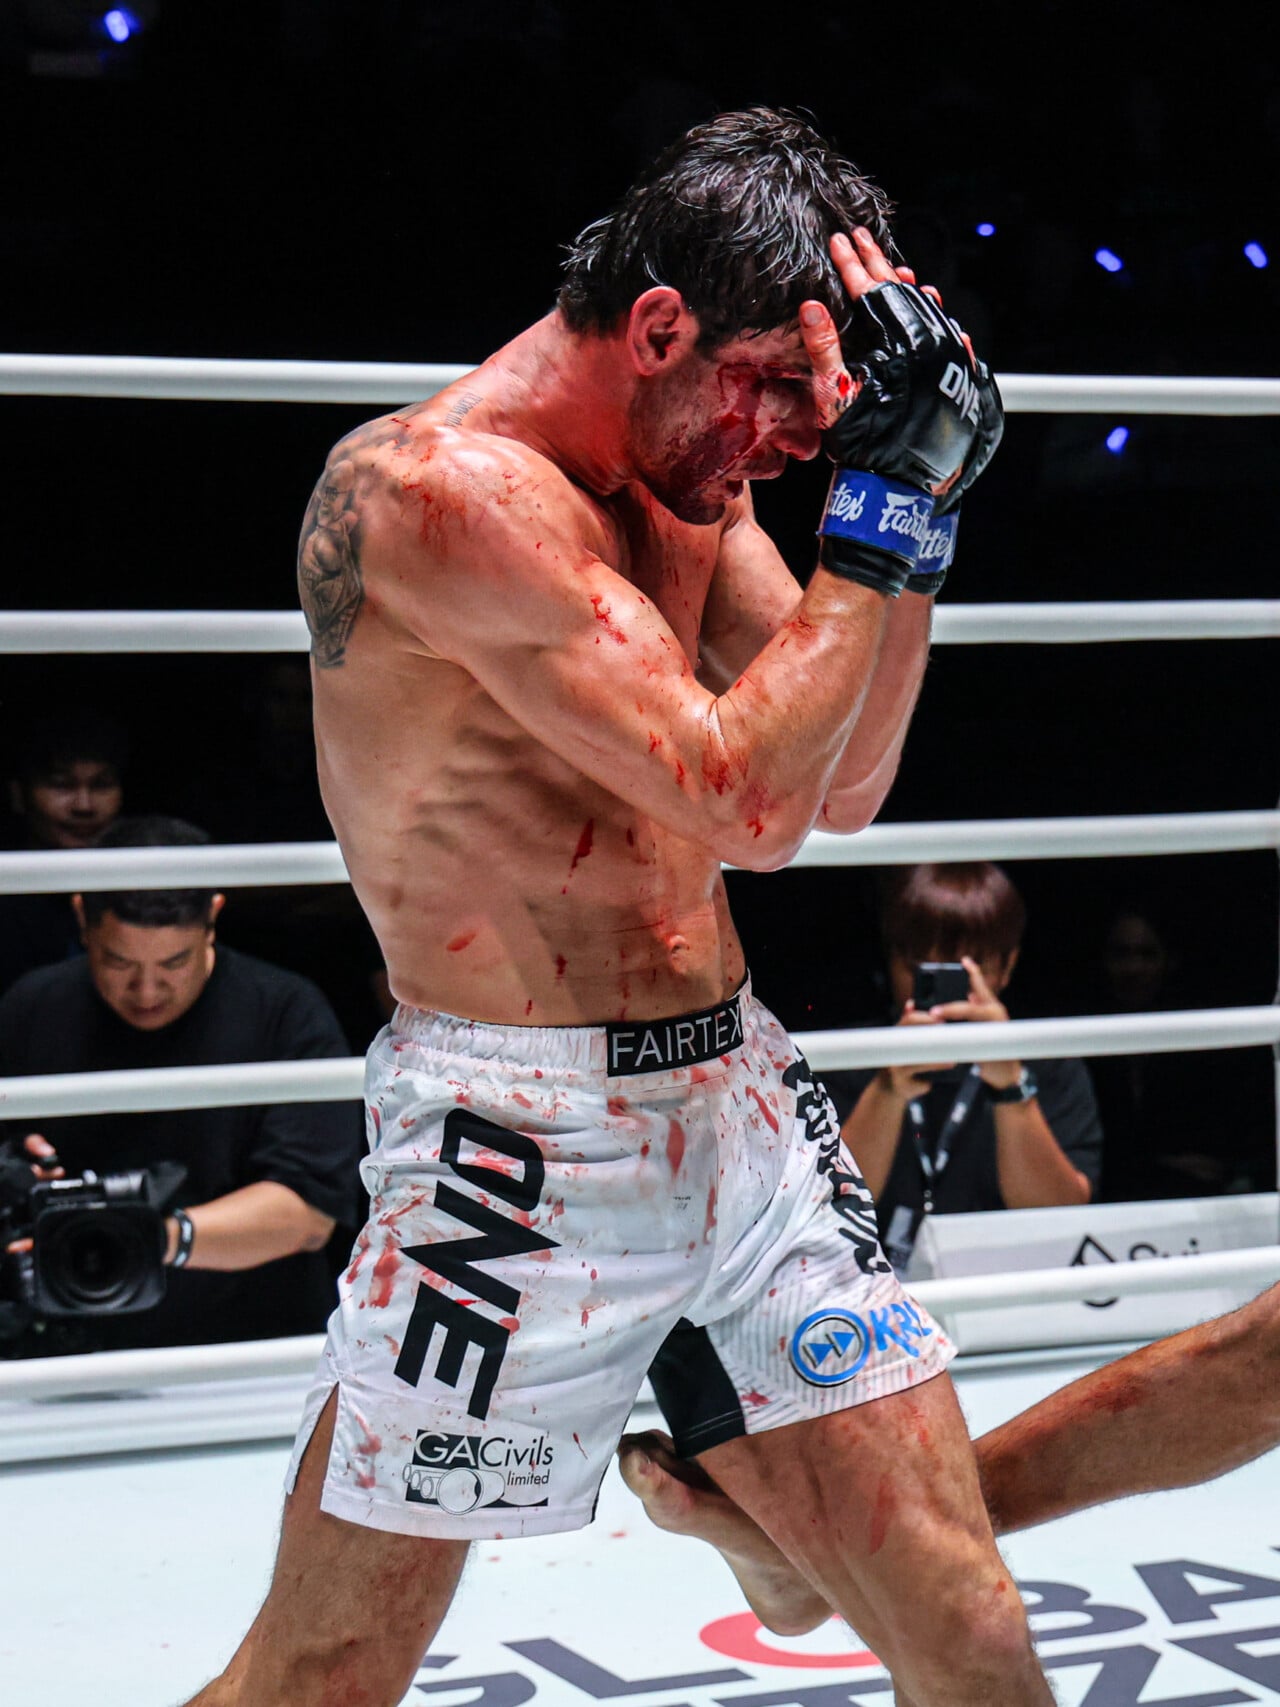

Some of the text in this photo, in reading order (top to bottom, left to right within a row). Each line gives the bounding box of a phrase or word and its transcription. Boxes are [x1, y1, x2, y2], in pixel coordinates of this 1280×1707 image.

[938, 361, 982, 426] ONE
[611, 1003, 743, 1069] FAIRTEX
[394, 1107, 561, 1421] ONE
[506, 1470, 550, 1486] limited
